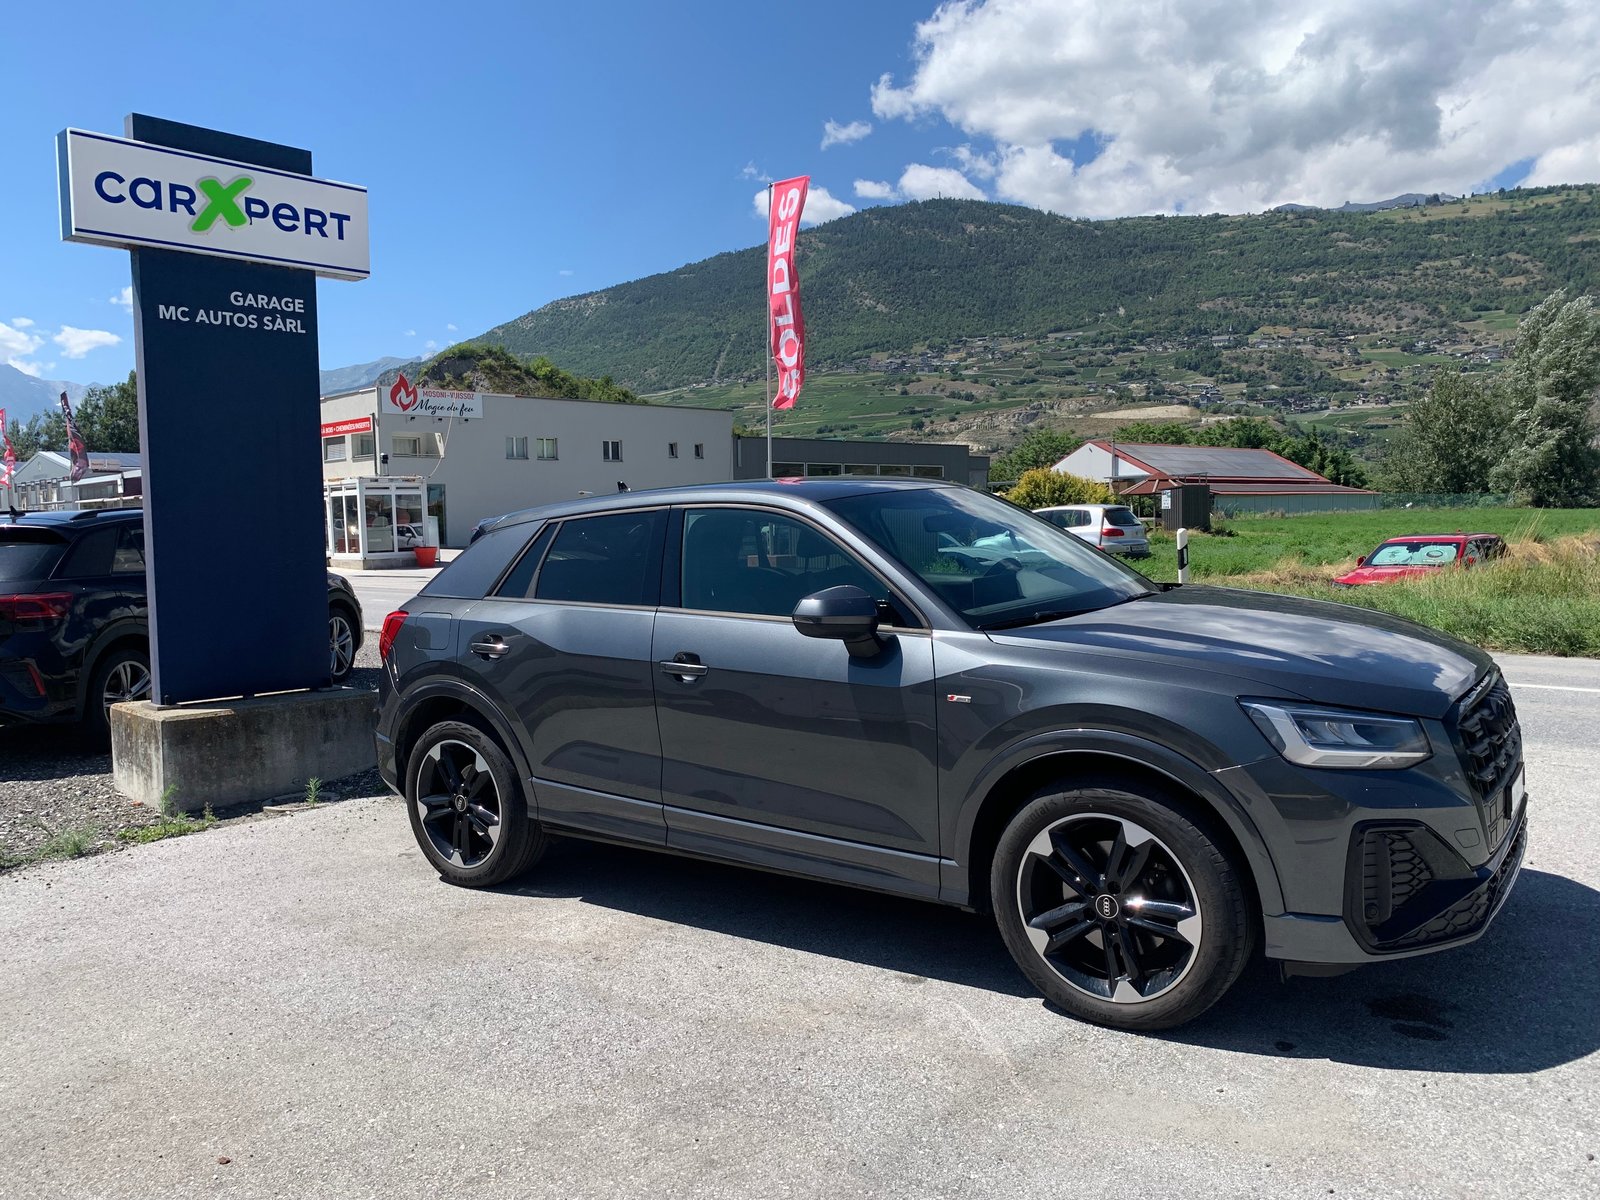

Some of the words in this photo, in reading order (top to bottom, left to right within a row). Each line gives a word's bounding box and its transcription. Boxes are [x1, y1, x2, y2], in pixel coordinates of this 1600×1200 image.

[229, 291, 305, 313] GARAGE
[772, 187, 801, 399] SOLDES
[158, 304, 190, 322] MC
[195, 308, 258, 330] AUTOS
[263, 313, 306, 334] SÀRL
[422, 390, 475, 401] MOSONI-VUISSOZ
[412, 398, 446, 415] Magie
[446, 401, 459, 412] du
[459, 403, 474, 417] feu
